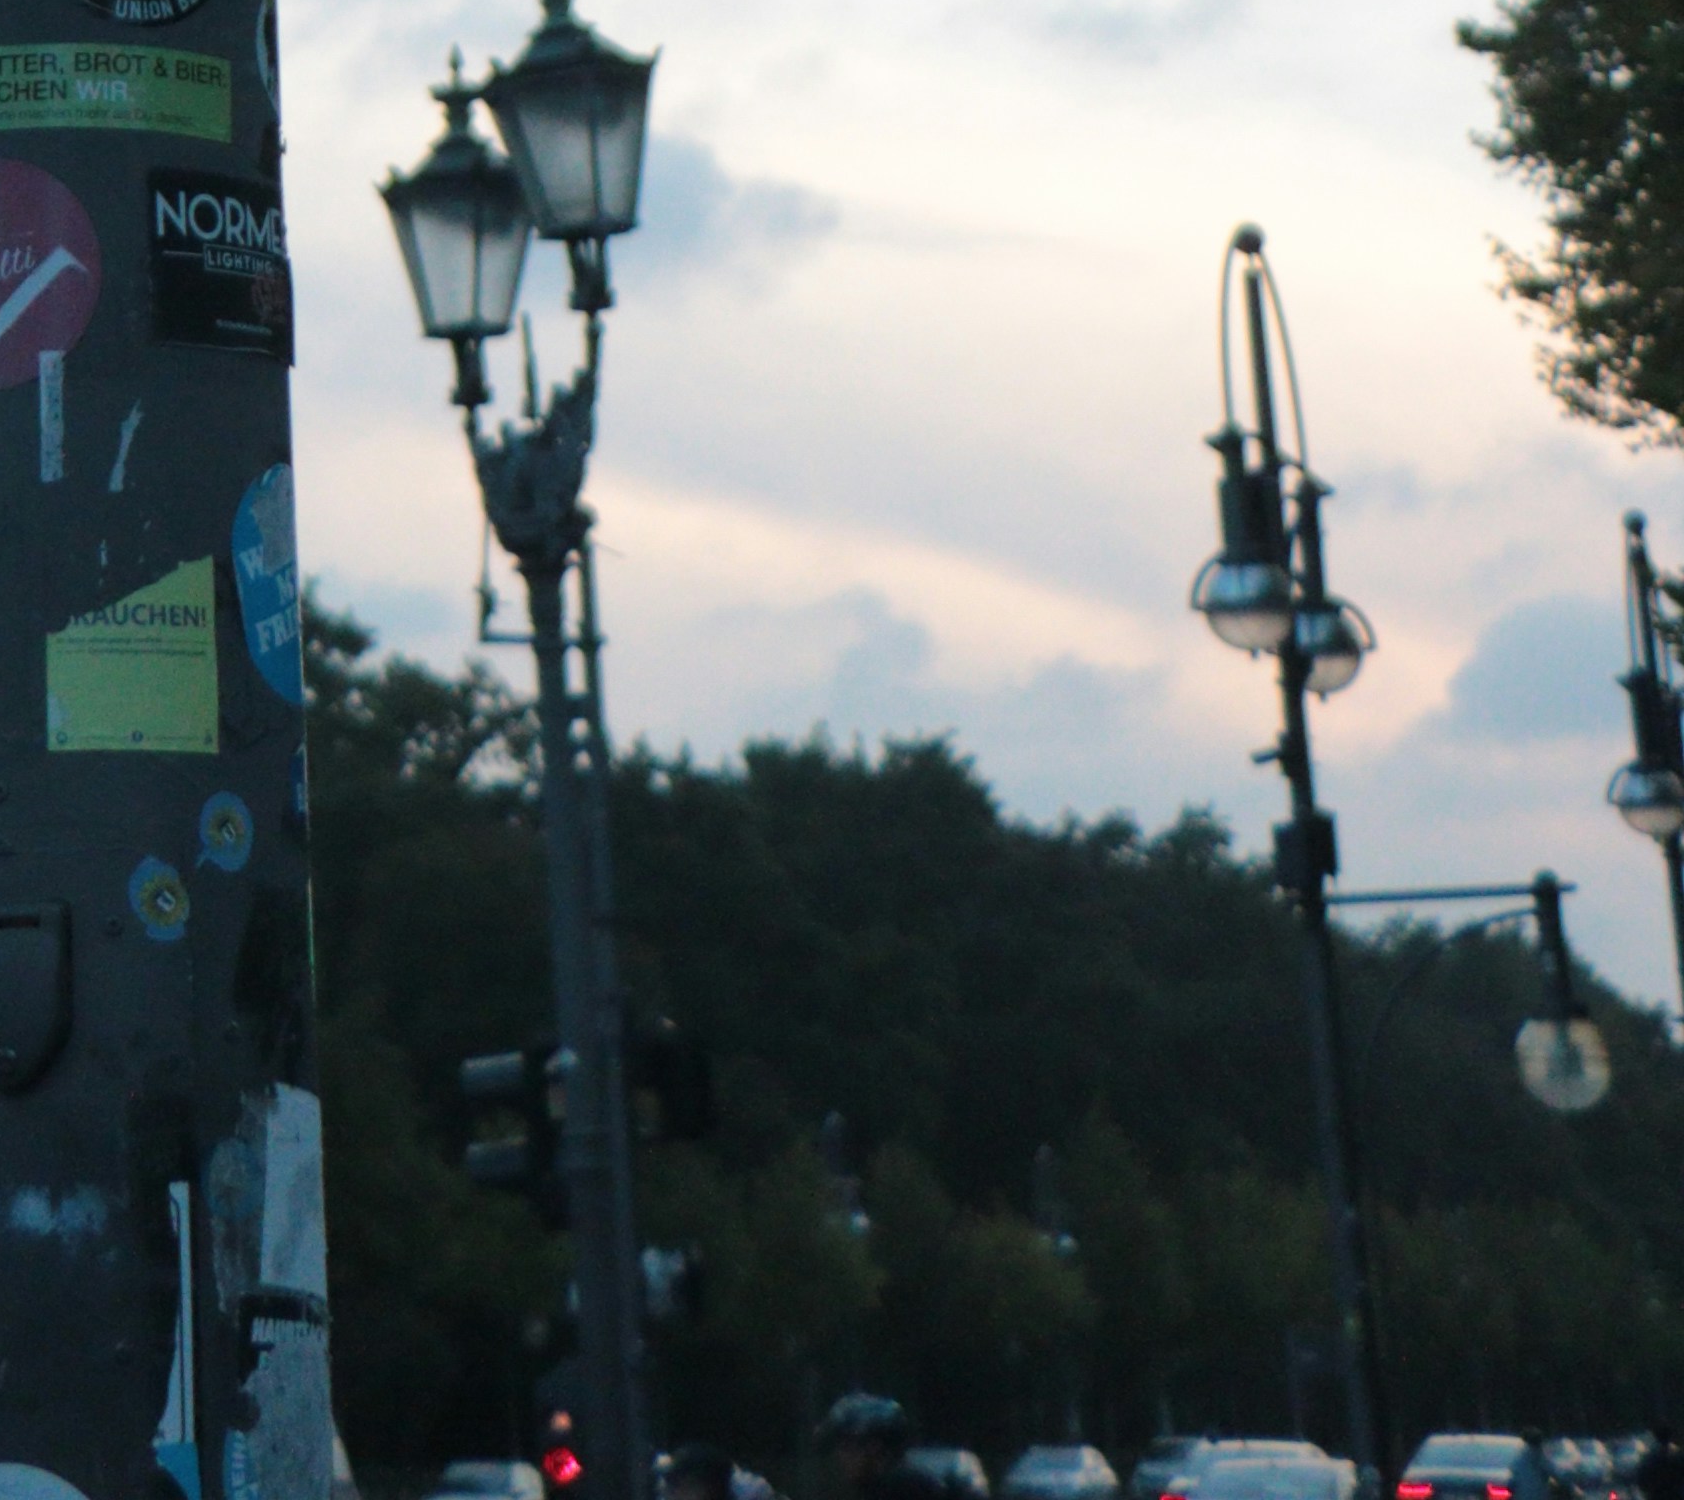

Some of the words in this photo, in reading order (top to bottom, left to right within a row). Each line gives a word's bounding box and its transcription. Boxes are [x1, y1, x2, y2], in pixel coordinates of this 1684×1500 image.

[74, 52, 147, 75] BROT
[153, 56, 168, 78] &
[207, 250, 274, 274] LIGHTING
